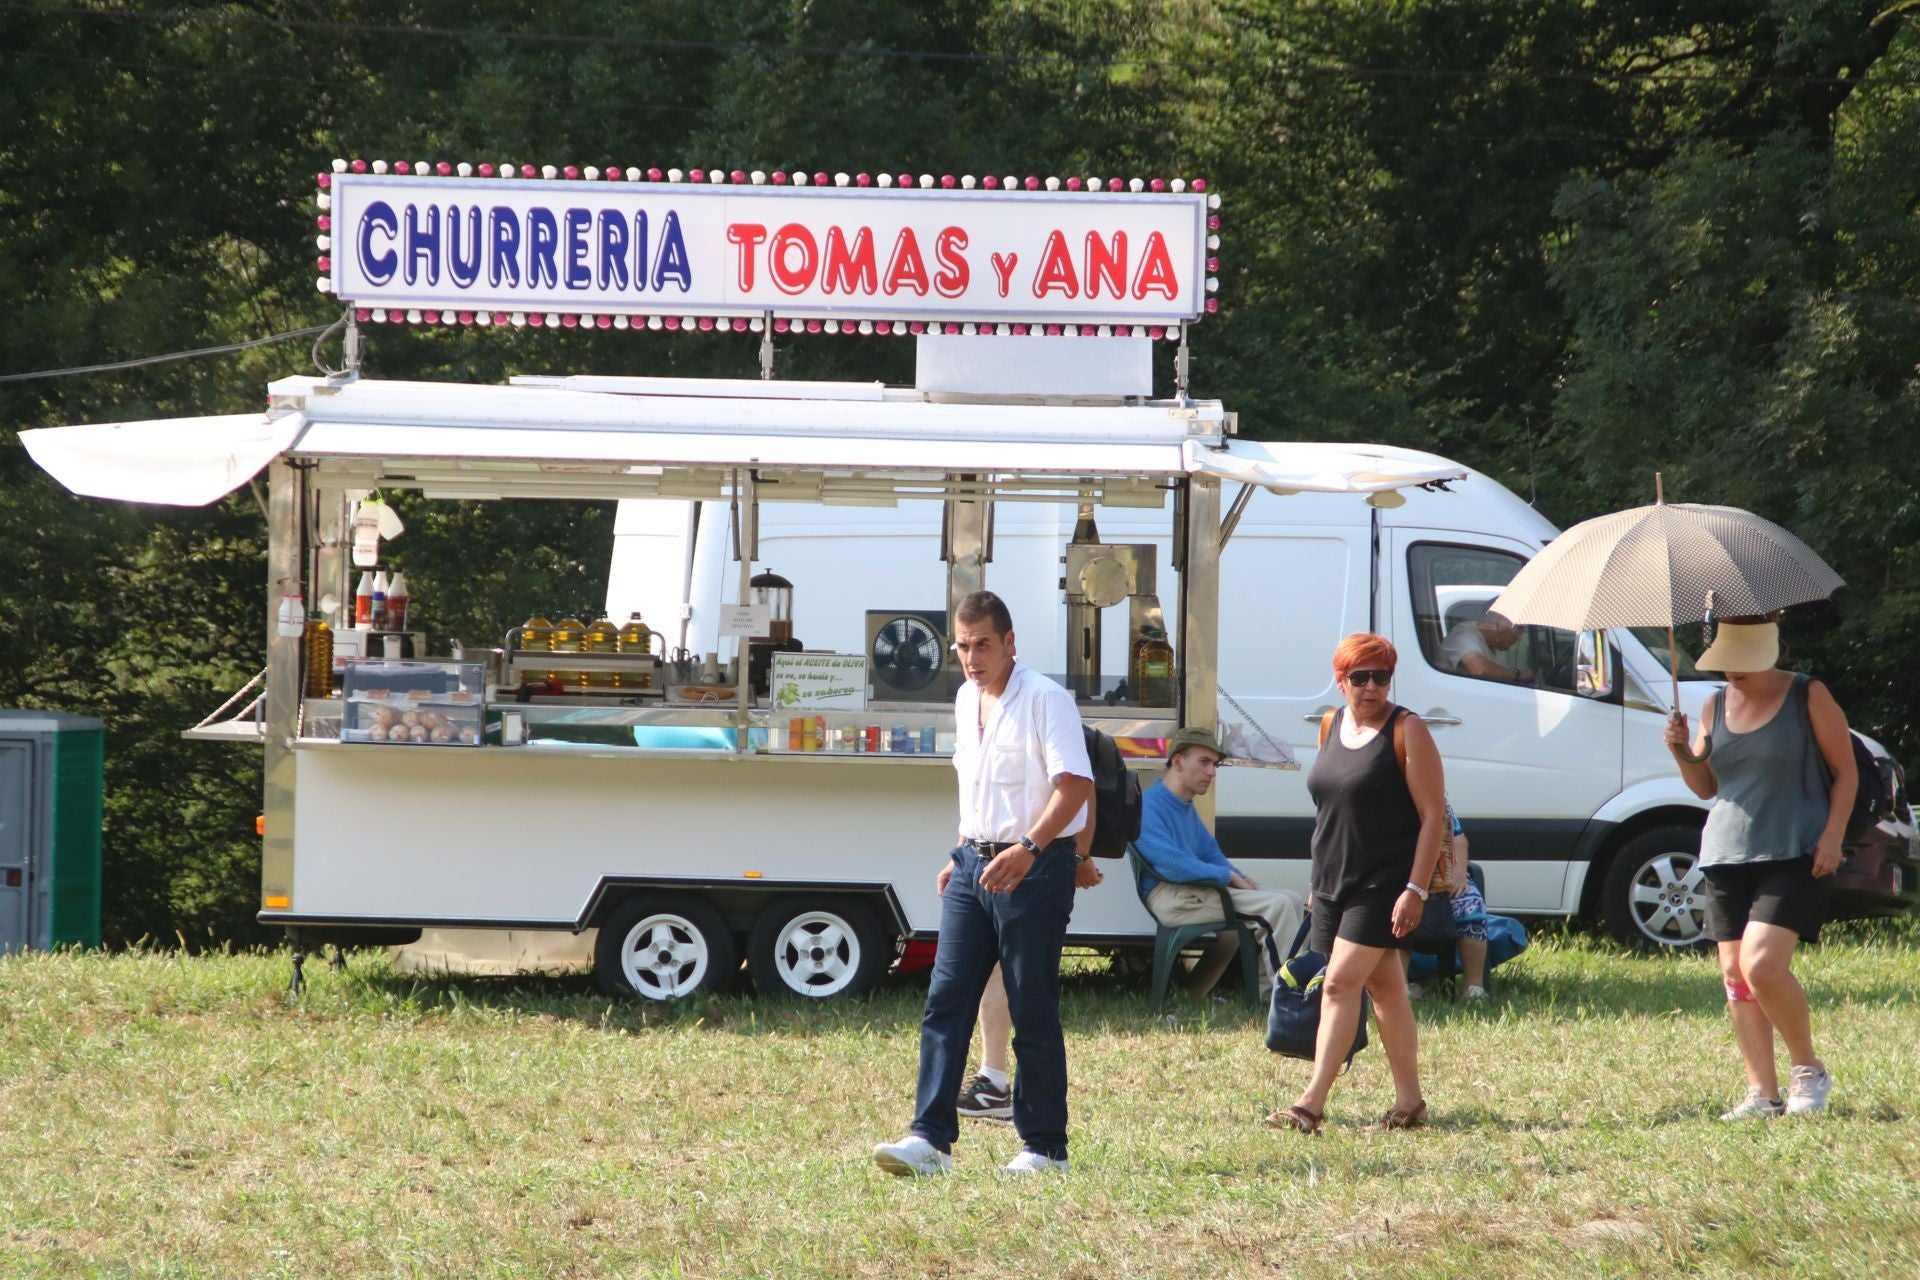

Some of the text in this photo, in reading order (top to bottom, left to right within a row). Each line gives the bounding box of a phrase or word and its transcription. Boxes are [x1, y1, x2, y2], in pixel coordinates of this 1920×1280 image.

[357, 200, 692, 291] CHURRERIA
[727, 222, 970, 299] TOMAS
[1032, 229, 1180, 301] ANA
[803, 658, 831, 667] ACEITE
[842, 659, 864, 668] OLIVA
